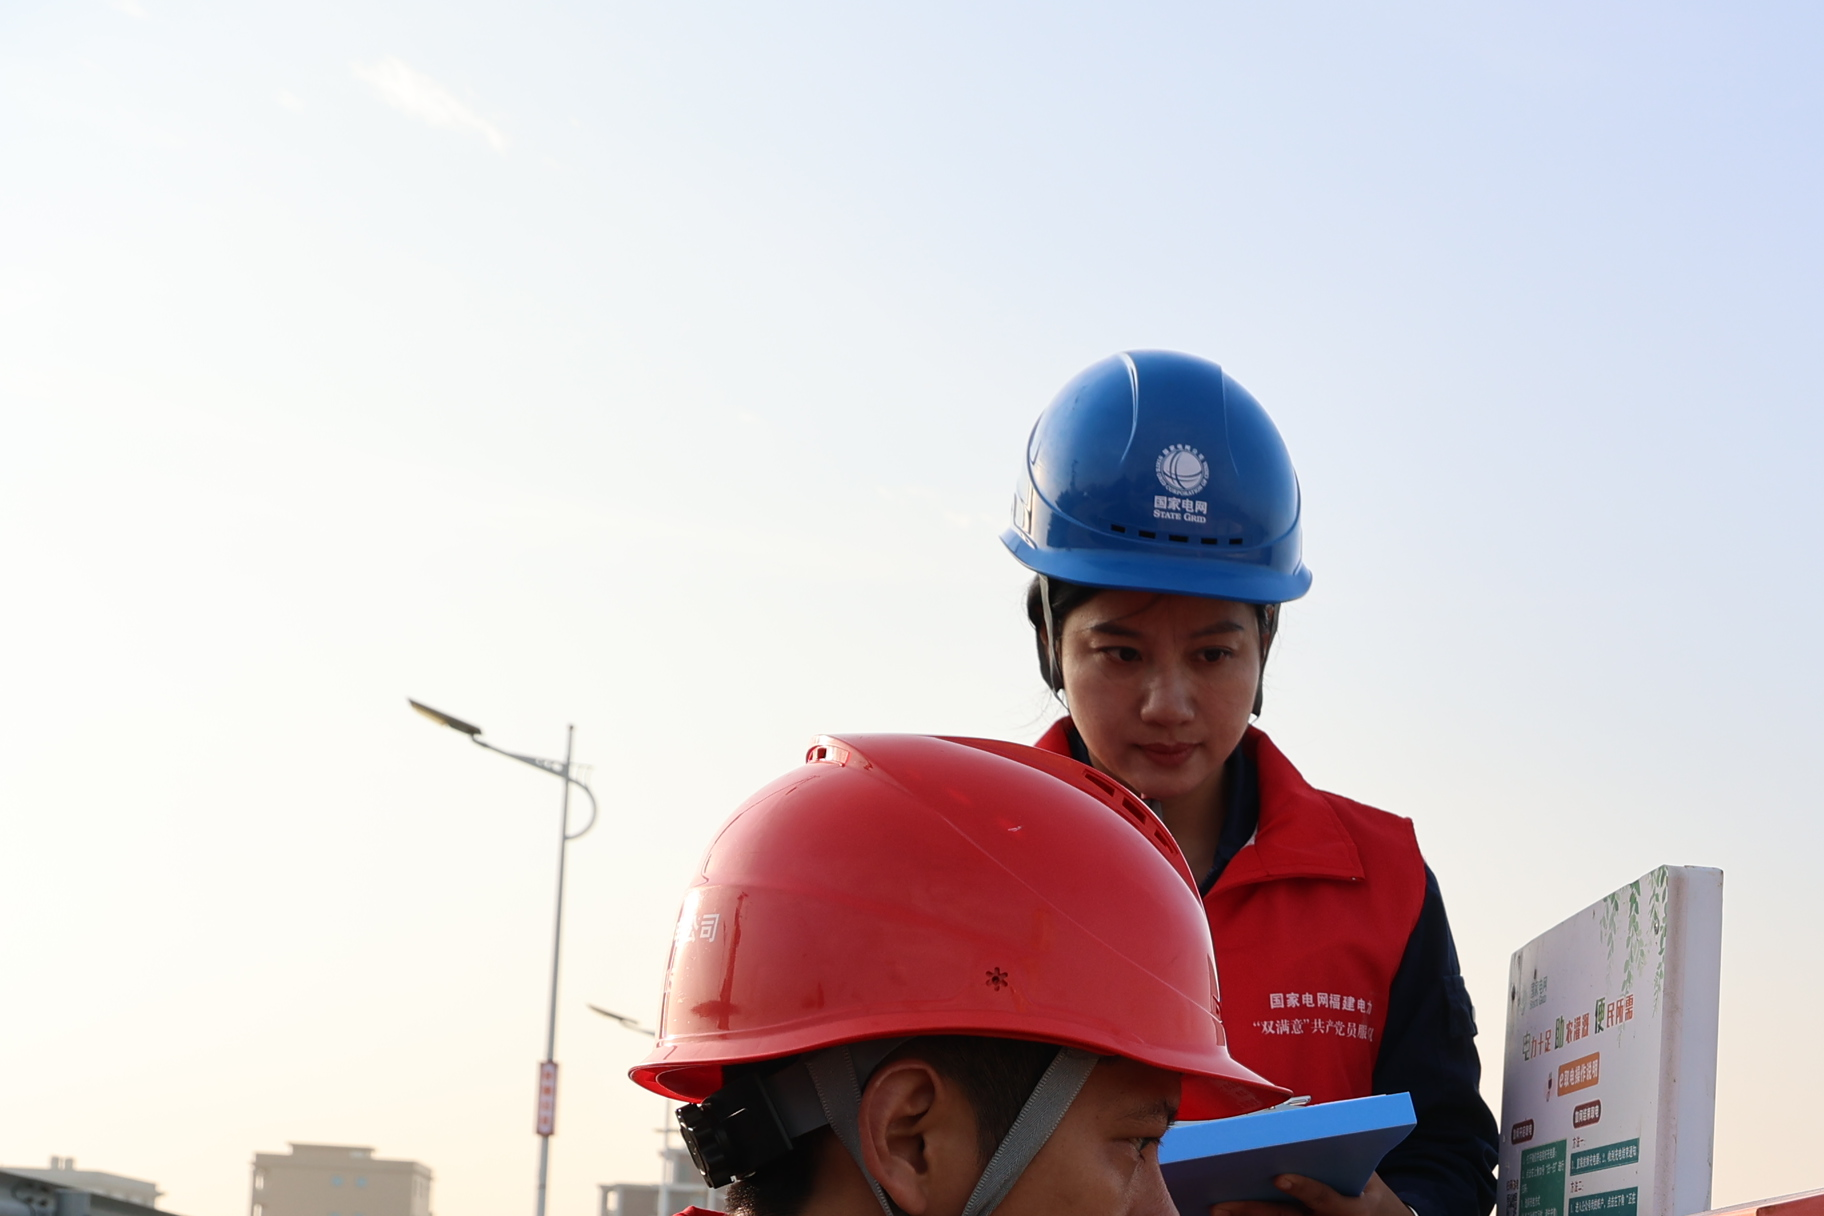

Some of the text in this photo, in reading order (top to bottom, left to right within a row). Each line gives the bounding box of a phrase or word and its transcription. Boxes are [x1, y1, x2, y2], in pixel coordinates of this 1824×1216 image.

[1153, 509, 1206, 524] STATE GRID
[1154, 495, 1208, 515] 国家电网
[1522, 993, 1635, 1062] 电力十足 助农灌溉 便民所需
[1559, 1059, 1599, 1089] e取电操作说明
